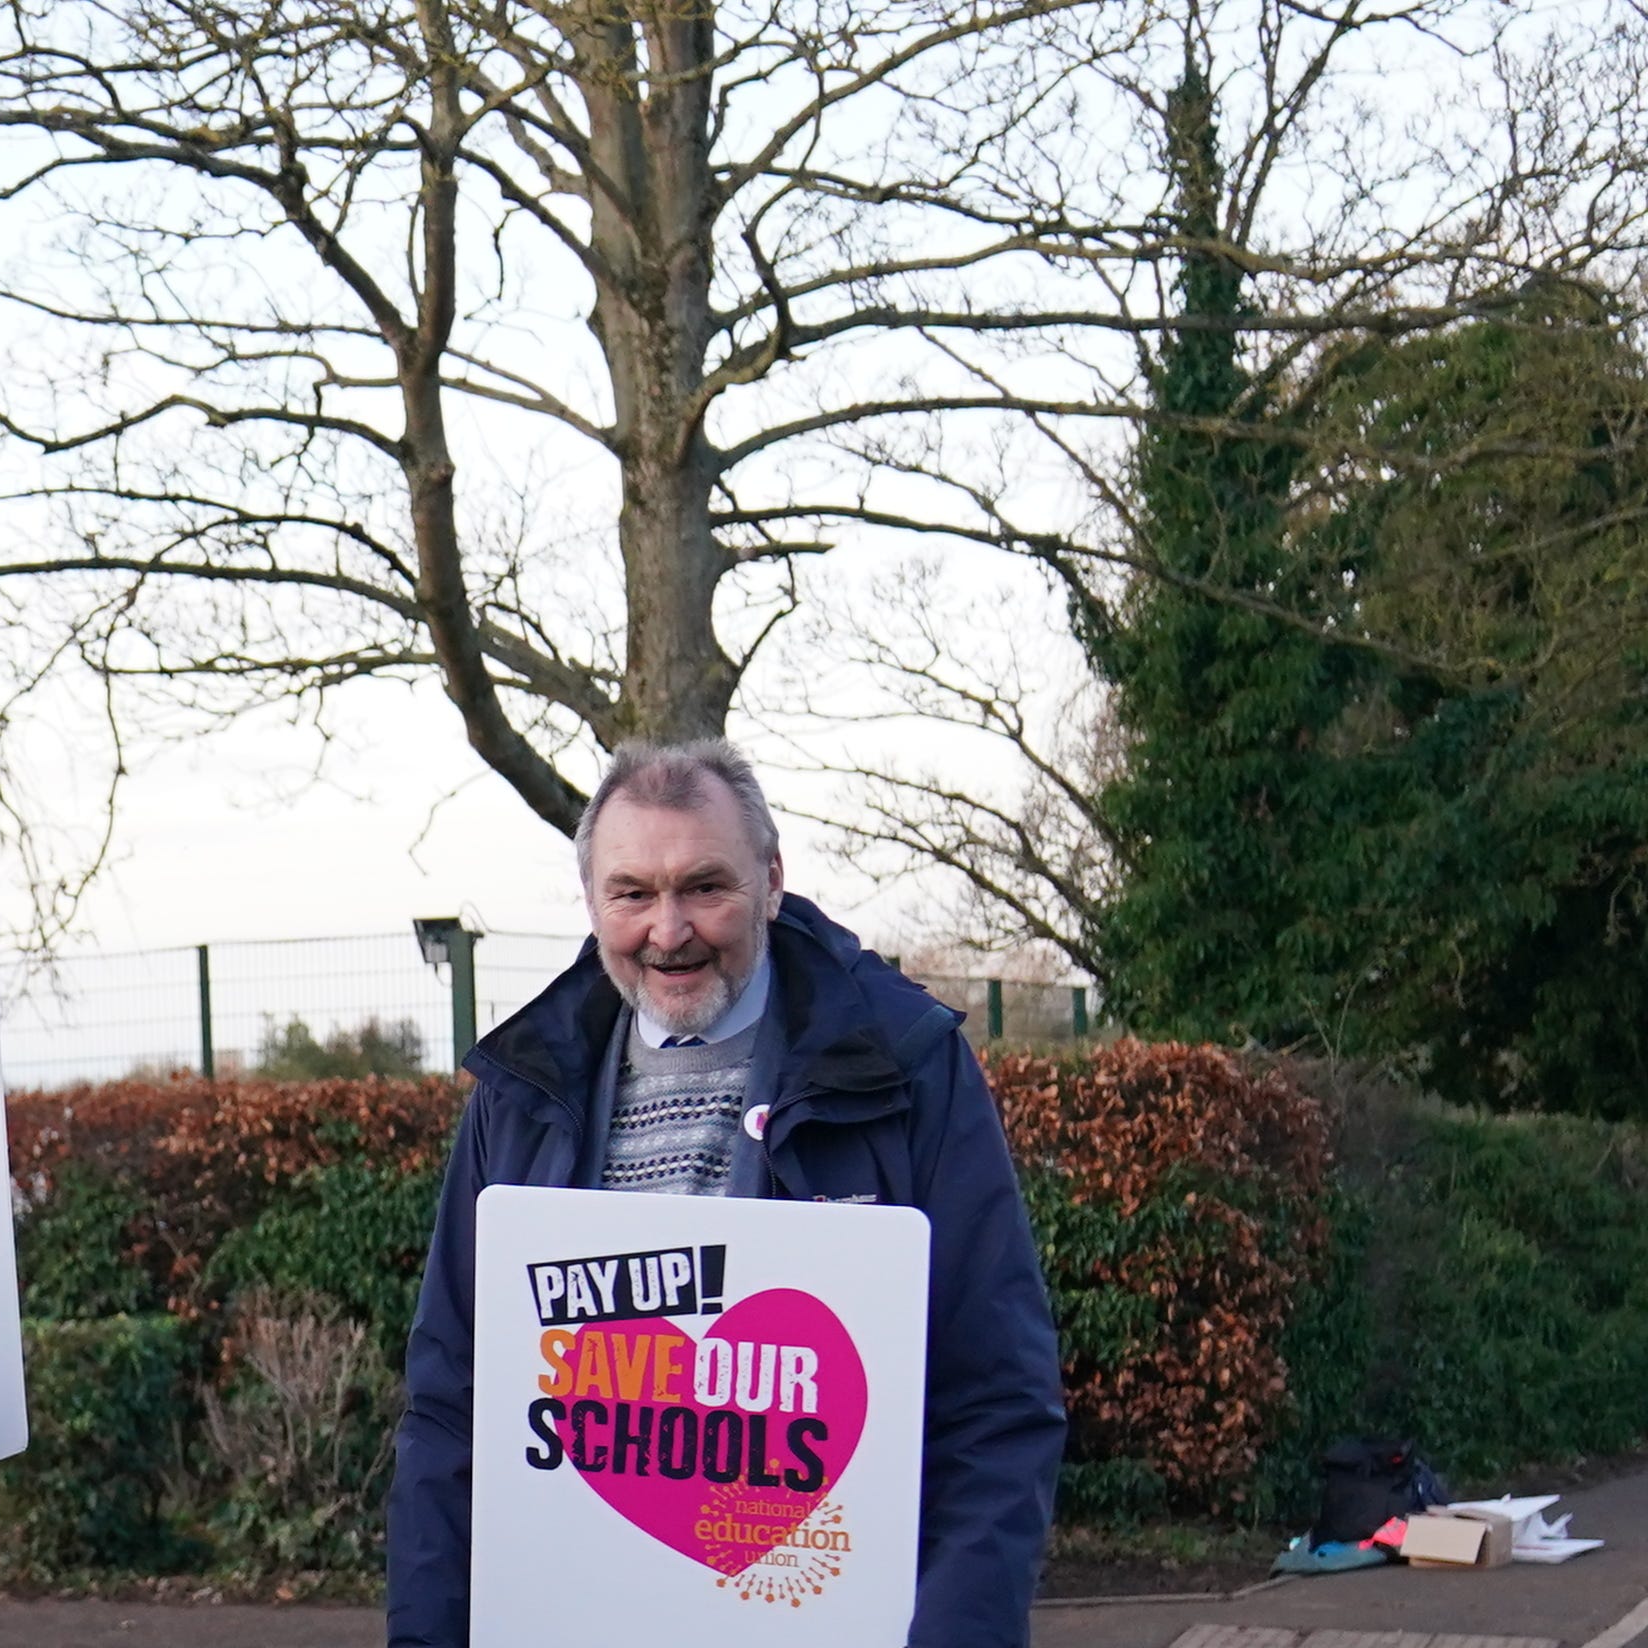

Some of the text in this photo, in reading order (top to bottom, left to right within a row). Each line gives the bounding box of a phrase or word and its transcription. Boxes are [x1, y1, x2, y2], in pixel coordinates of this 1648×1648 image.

[534, 1244, 726, 1319] PAY UP!
[538, 1329, 818, 1413] SAVE OUR
[525, 1398, 828, 1493] SCHOOLS
[694, 1513, 851, 1552] education
[735, 1499, 812, 1519] national
[745, 1549, 800, 1567] union
